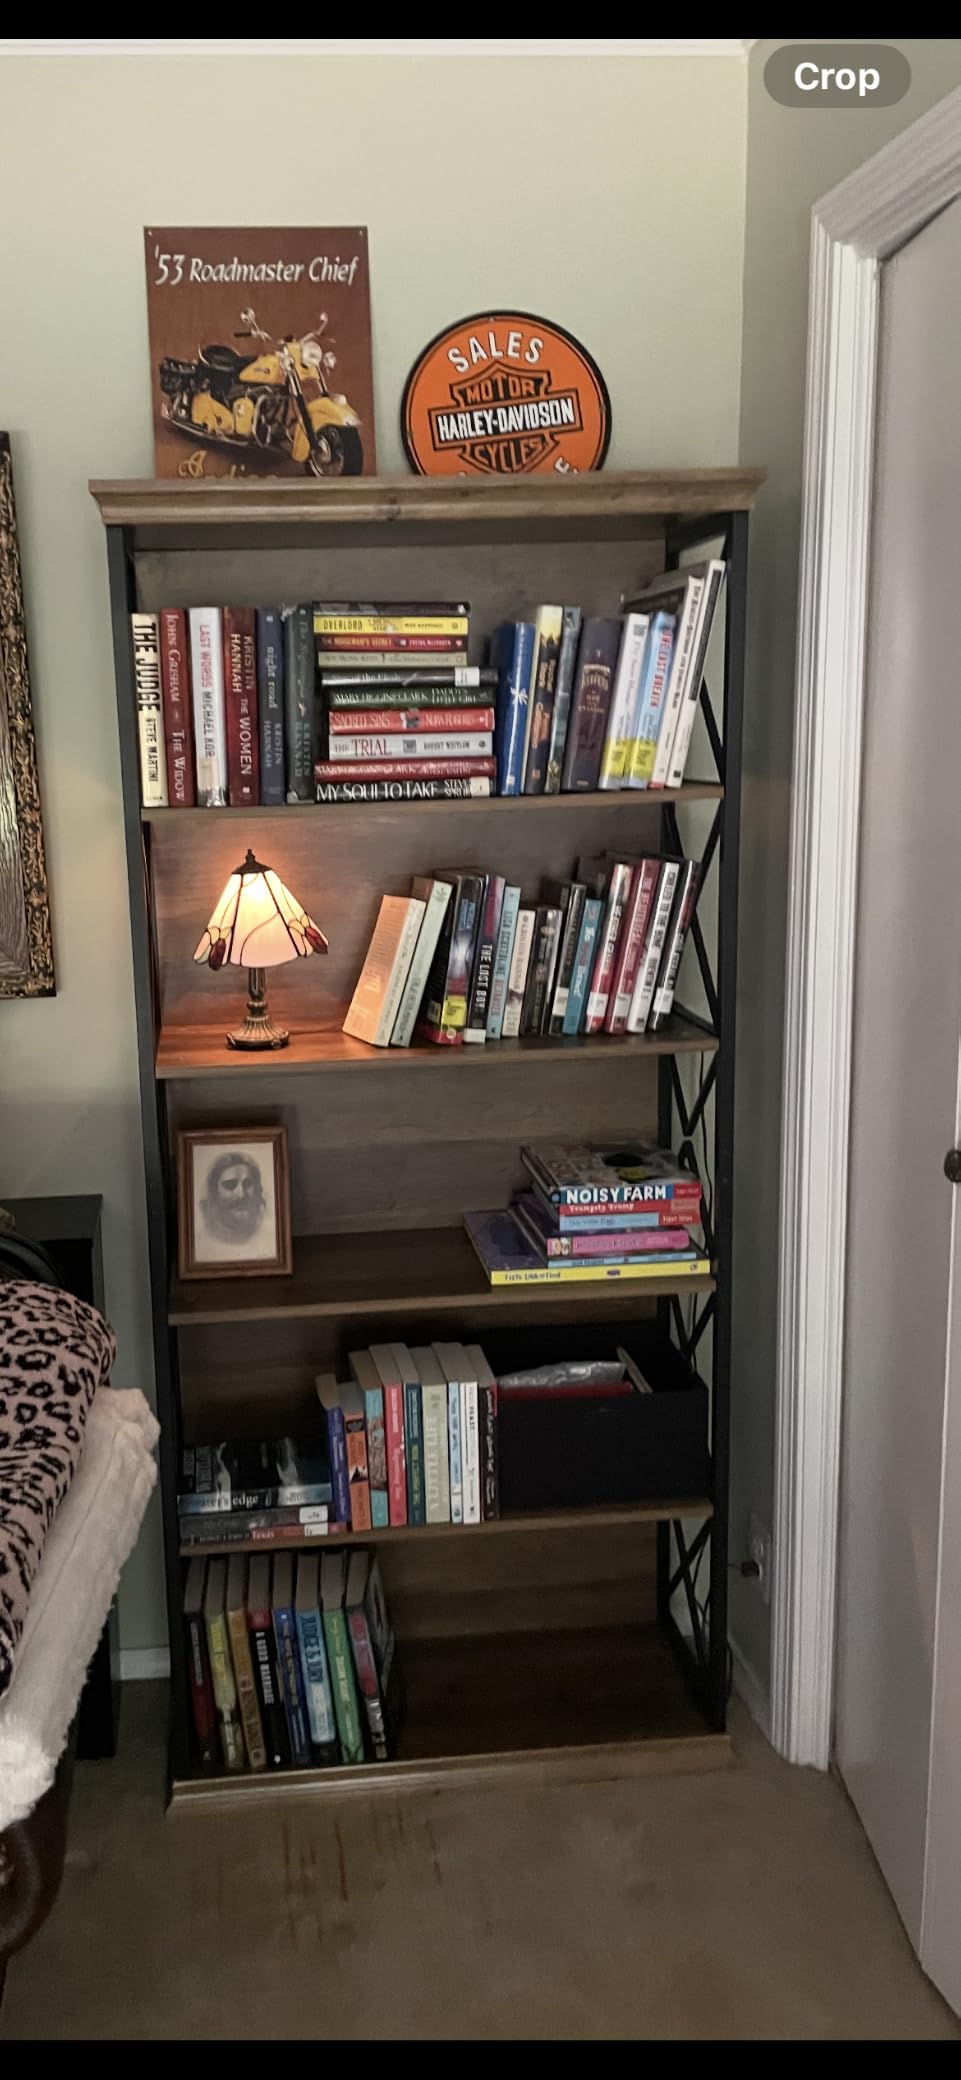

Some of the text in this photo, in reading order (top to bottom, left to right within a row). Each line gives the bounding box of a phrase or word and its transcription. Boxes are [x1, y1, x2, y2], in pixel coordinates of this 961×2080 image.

[154, 244, 360, 286] '53 Roadmaster Chief
[447, 331, 545, 374] SALES
[466, 373, 536, 404] MOTOR
[437, 398, 575, 442] HARLEY-DAVIDSON
[474, 436, 543, 472] CYCLES
[199, 624, 211, 649] LAST
[323, 619, 363, 630] OVERLORD
[134, 622, 161, 712] THE JUDGE
[166, 614, 181, 702] JOHN GRISHAM
[200, 650, 214, 688] WORDS
[230, 633, 243, 693] HANNAH
[243, 636, 256, 690] KRISTIN
[264, 646, 279, 709] night road
[201, 691, 214, 735] MICHAEL
[334, 712, 391, 729] SACRED SINS
[145, 718, 159, 781] STEVE MARTINI
[239, 716, 252, 775] WOMEN
[352, 738, 392, 757] TRIAL
[174, 756, 186, 800] WIDOW
[316, 784, 338, 801] MY
[343, 782, 379, 800] SOUL
[384, 782, 407, 799] TO
[408, 781, 438, 798] TAKE
[475, 944, 492, 1009] THE LOST BOY
[566, 1188, 621, 1204] NOISY
[623, 1185, 667, 1201] FARM
[233, 1494, 259, 1506] edge
